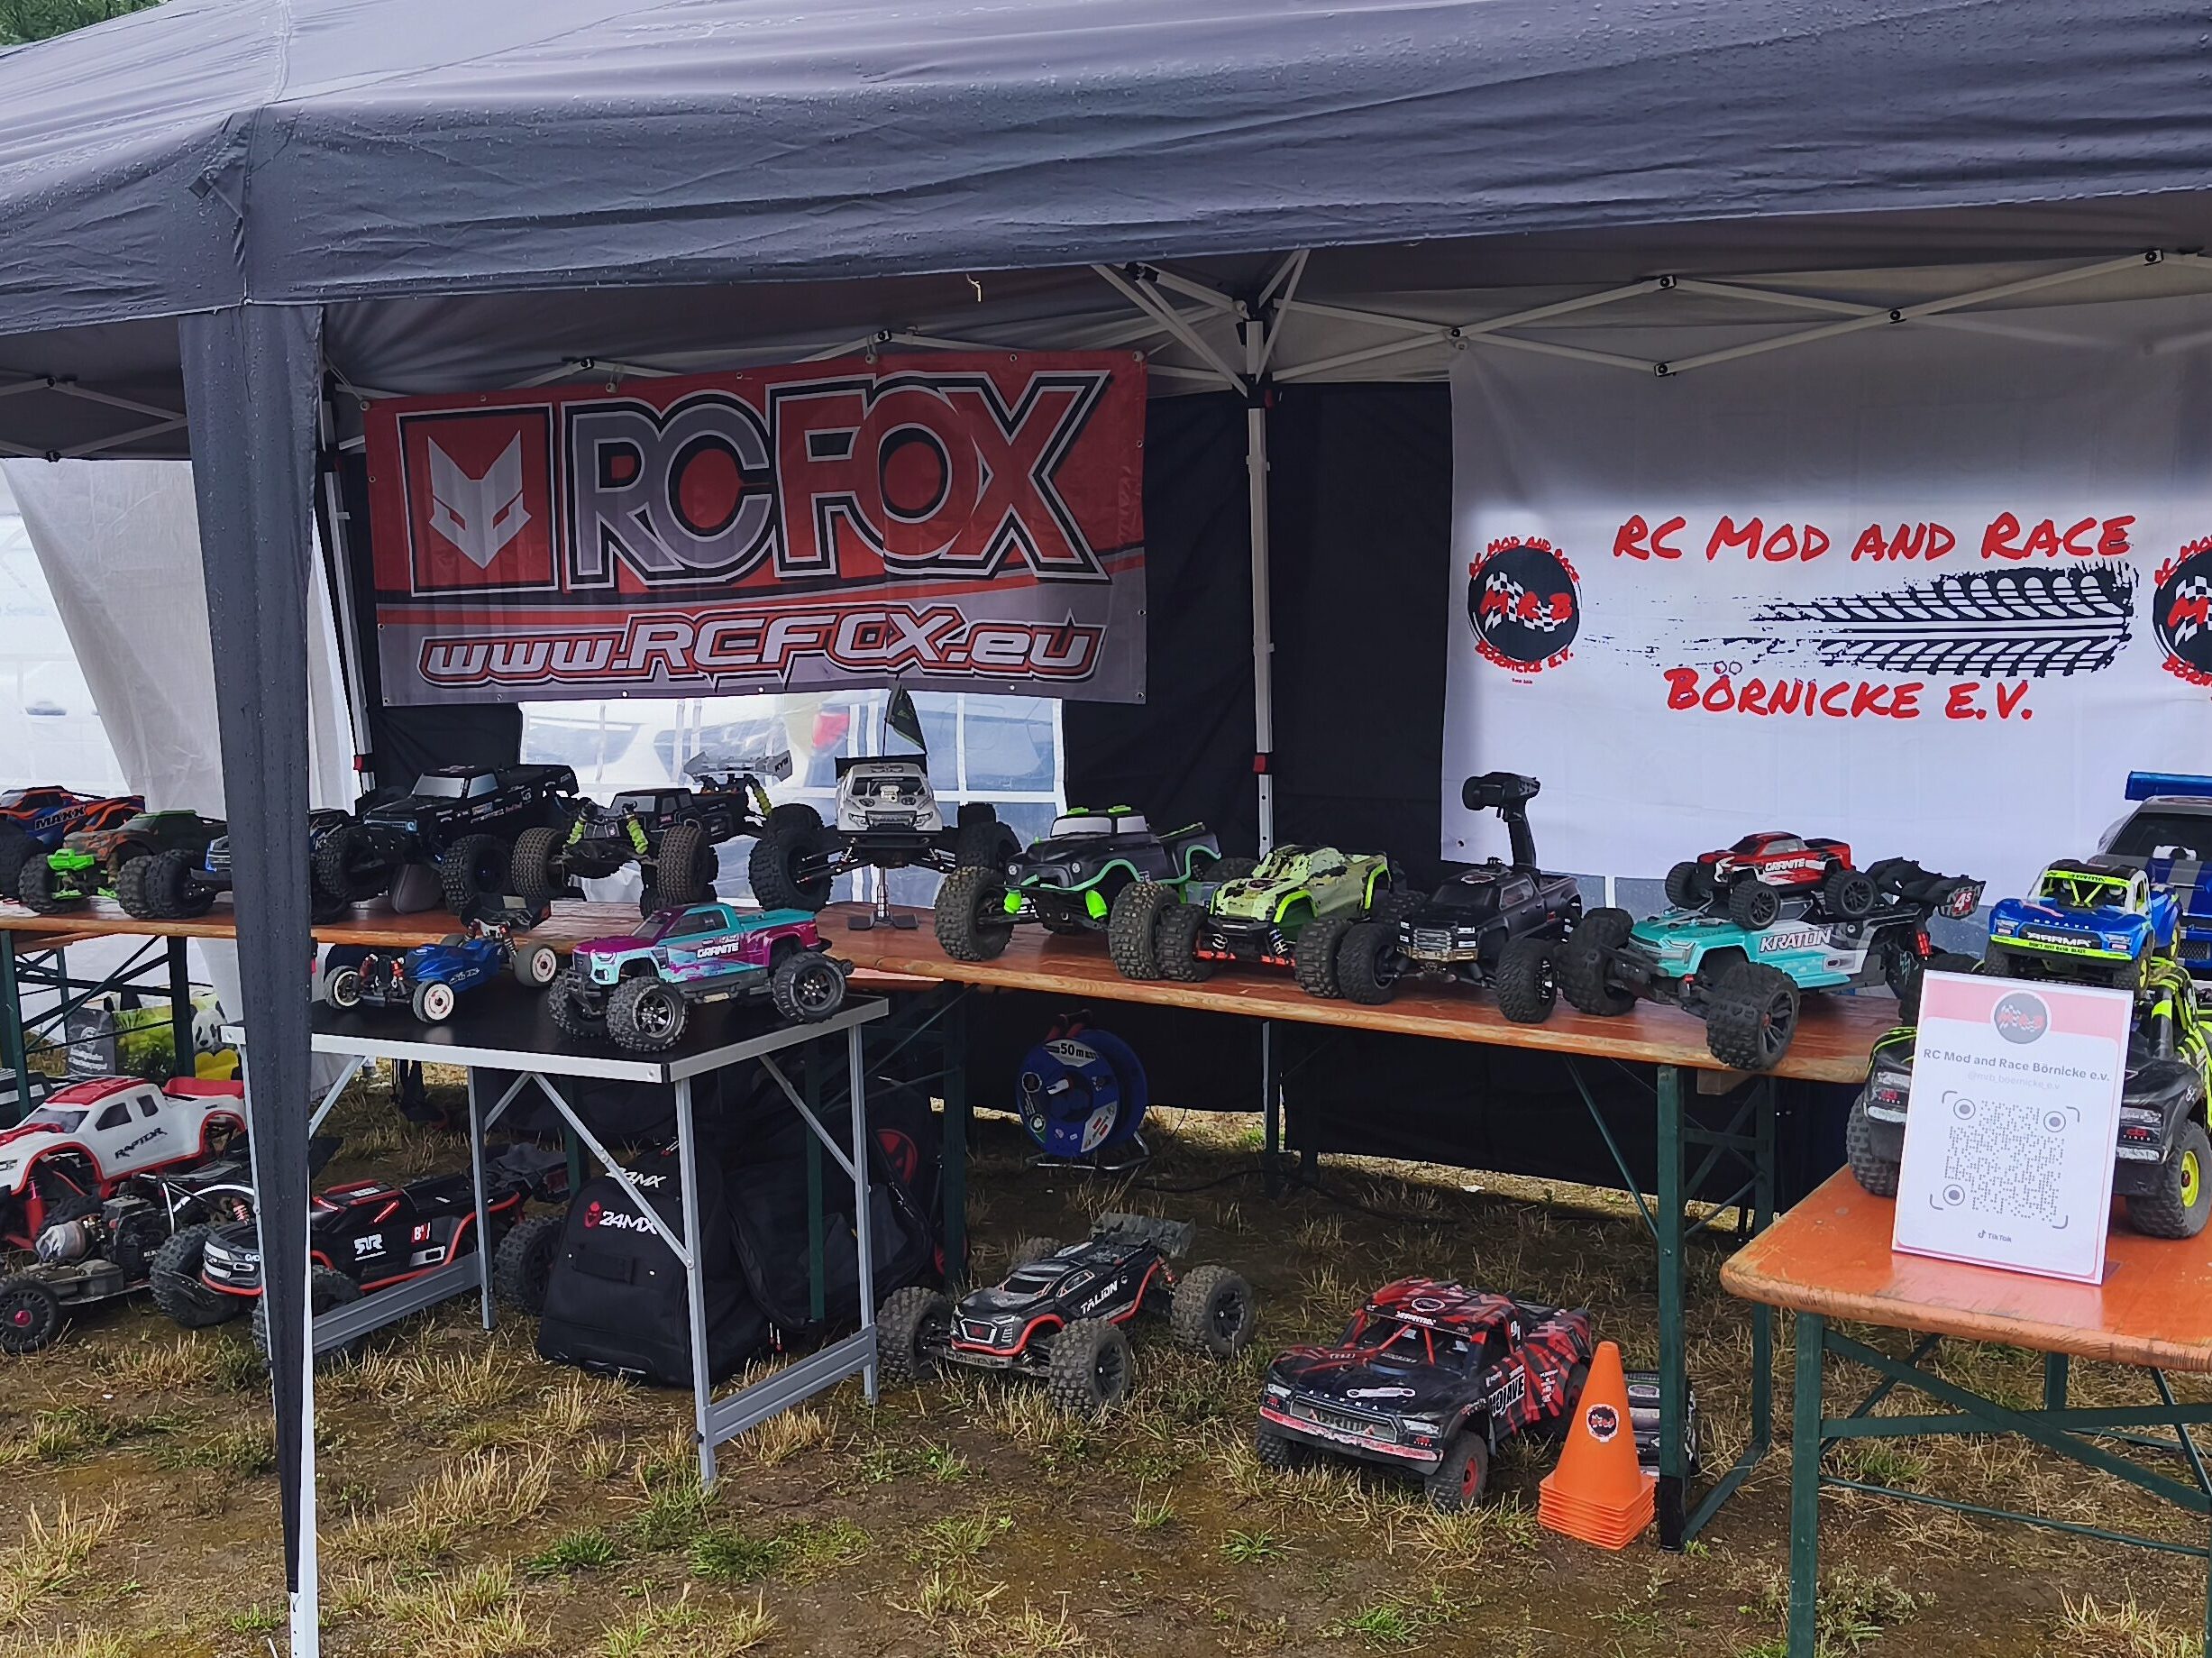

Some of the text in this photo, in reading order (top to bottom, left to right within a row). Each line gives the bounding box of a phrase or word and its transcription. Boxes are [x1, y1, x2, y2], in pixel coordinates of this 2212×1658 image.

[1613, 515, 1686, 561] RC
[2180, 536, 2212, 564] MO
[420, 606, 1103, 682] www.RCFOX.eu
[34, 805, 86, 830] MAXX
[1765, 858, 1805, 872] GRANITE
[697, 942, 739, 958] GRANITE
[1760, 929, 1832, 953] KRATON
[1060, 1042, 1075, 1056] 50
[1075, 1049, 1084, 1058] m
[1924, 1049, 2110, 1082] RC Mod and Race Börnicke e.v.
[114, 1127, 169, 1159] RAPTOR
[1081, 1280, 1118, 1314] TALION
